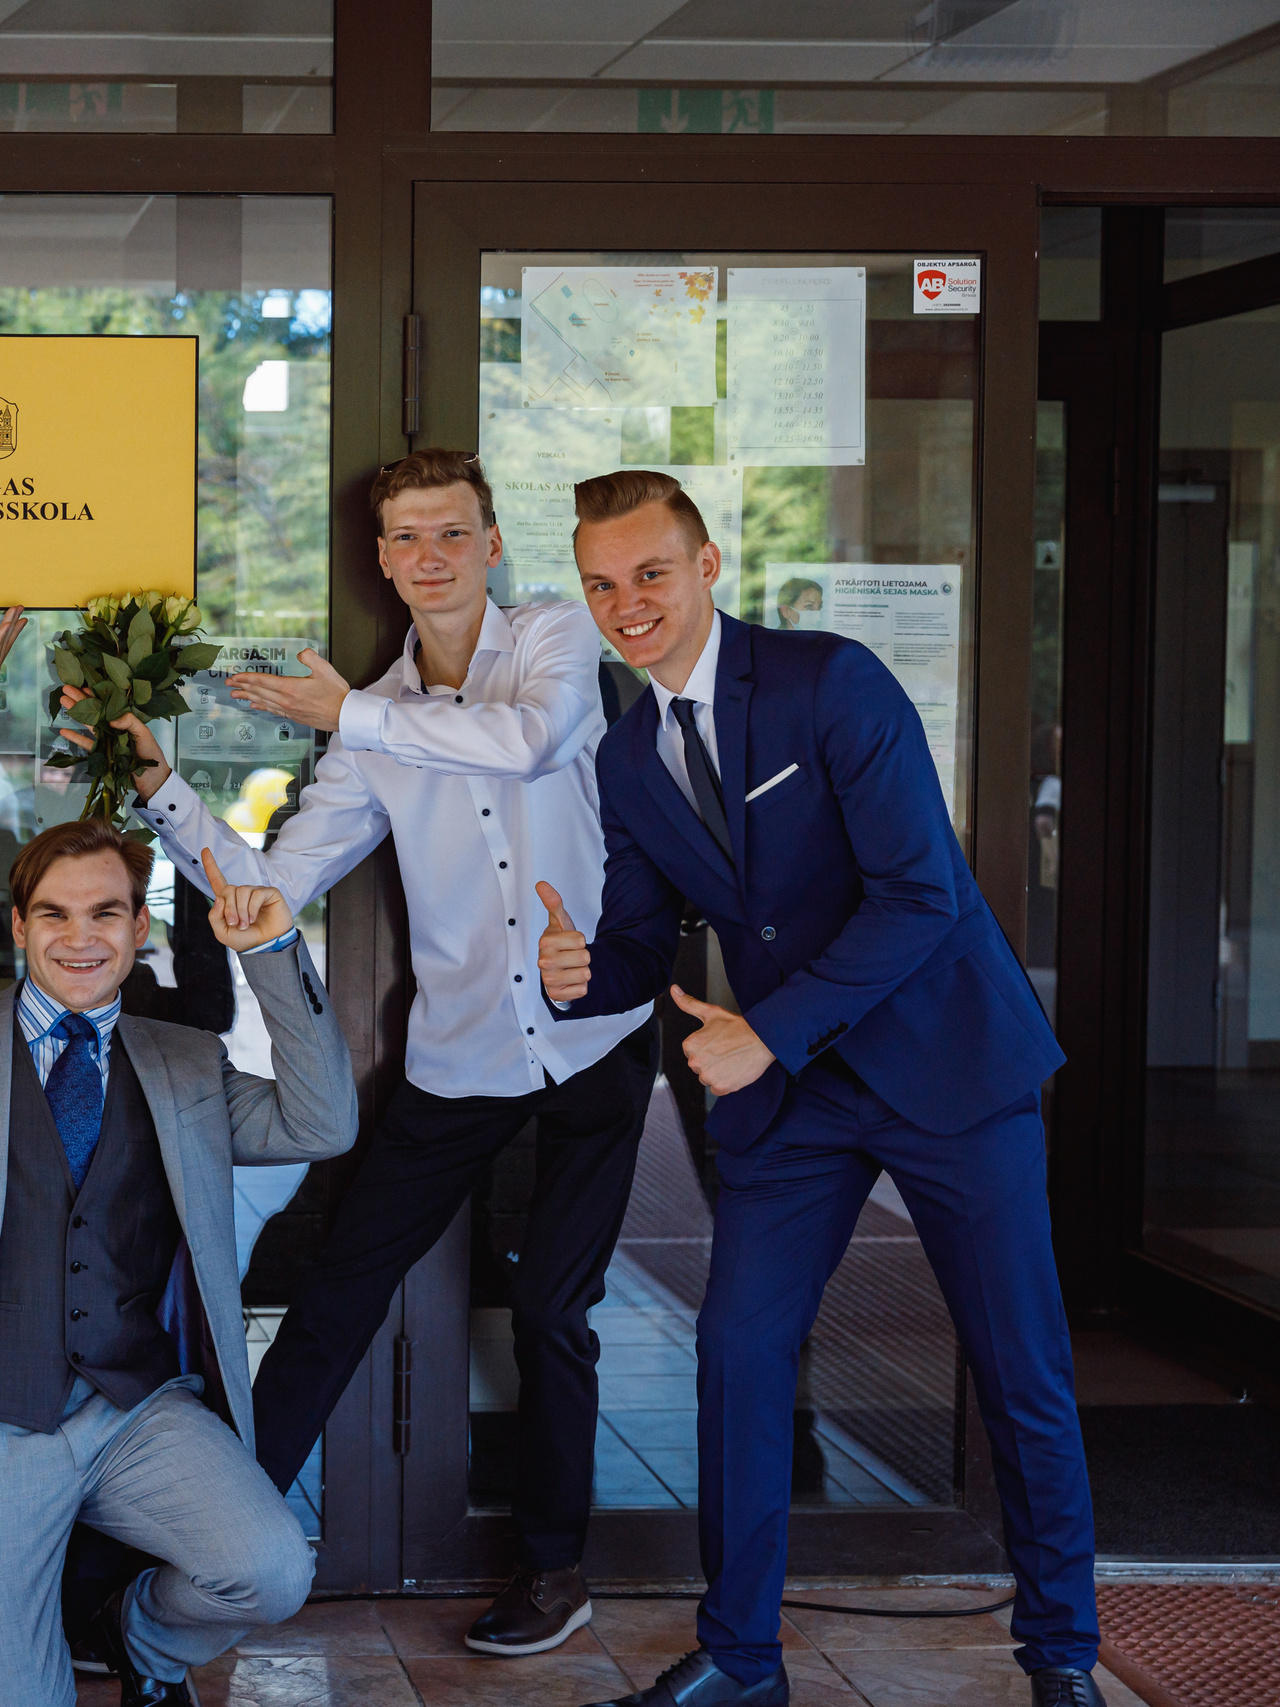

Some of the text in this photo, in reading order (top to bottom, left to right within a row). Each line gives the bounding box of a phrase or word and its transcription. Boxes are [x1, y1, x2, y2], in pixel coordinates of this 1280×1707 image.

[921, 278, 944, 292] AB
[948, 285, 976, 293] Security
[773, 378, 794, 386] 12.10
[803, 378, 824, 386] 12.50
[505, 482, 551, 491] SKOLAS
[835, 578, 927, 588] ATKĀRTOTI LIETOJAMA
[835, 586, 882, 595] HIGIĒNISKĀ
[883, 588, 908, 596] SEJAS
[218, 645, 286, 660] ARGĀSIM
